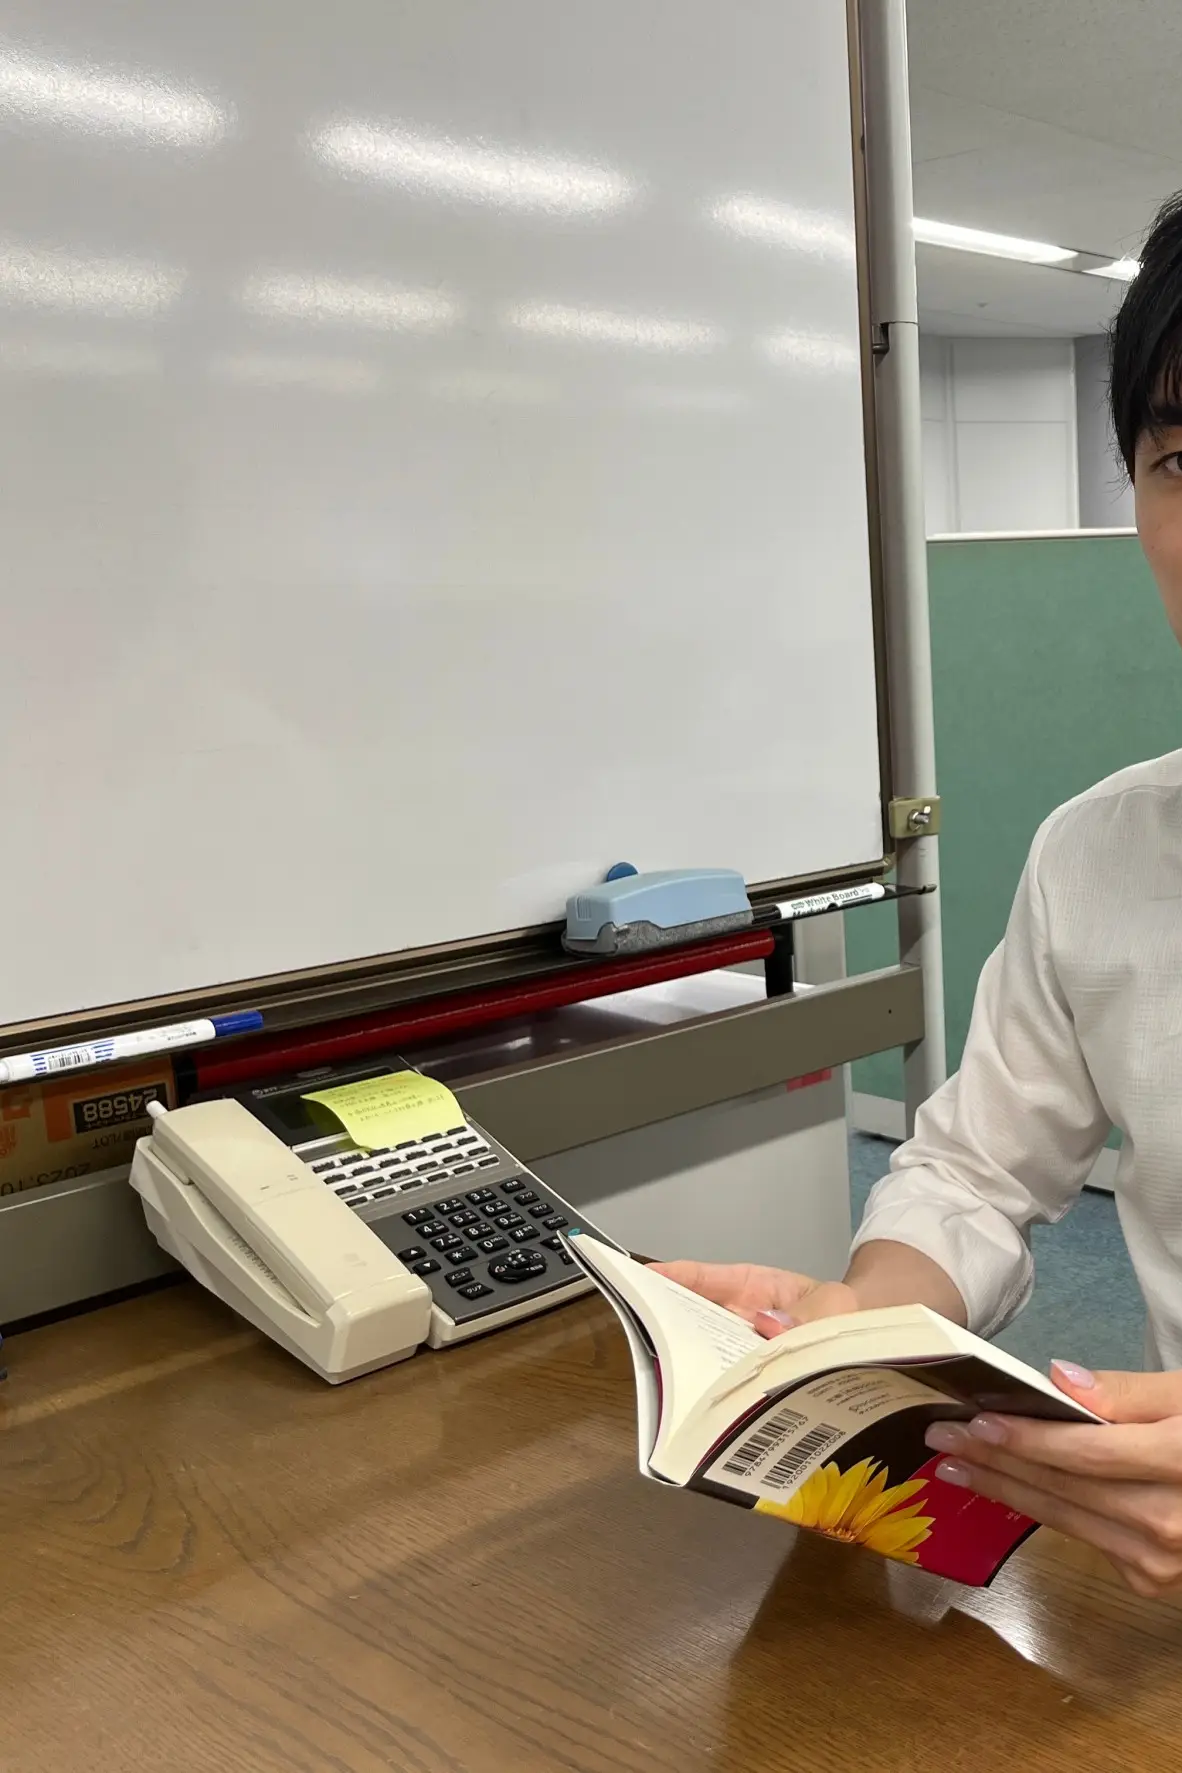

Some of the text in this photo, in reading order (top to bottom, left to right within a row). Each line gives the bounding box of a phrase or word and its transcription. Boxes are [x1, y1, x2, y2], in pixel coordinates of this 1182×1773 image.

[804, 896, 832, 908] White
[832, 888, 860, 901] Board
[470, 1193, 480, 1201] 3
[440, 1203, 450, 1211] 2
[485, 1205, 495, 1213] 6
[499, 1217, 509, 1225] 9
[436, 1238, 445, 1246] 7
